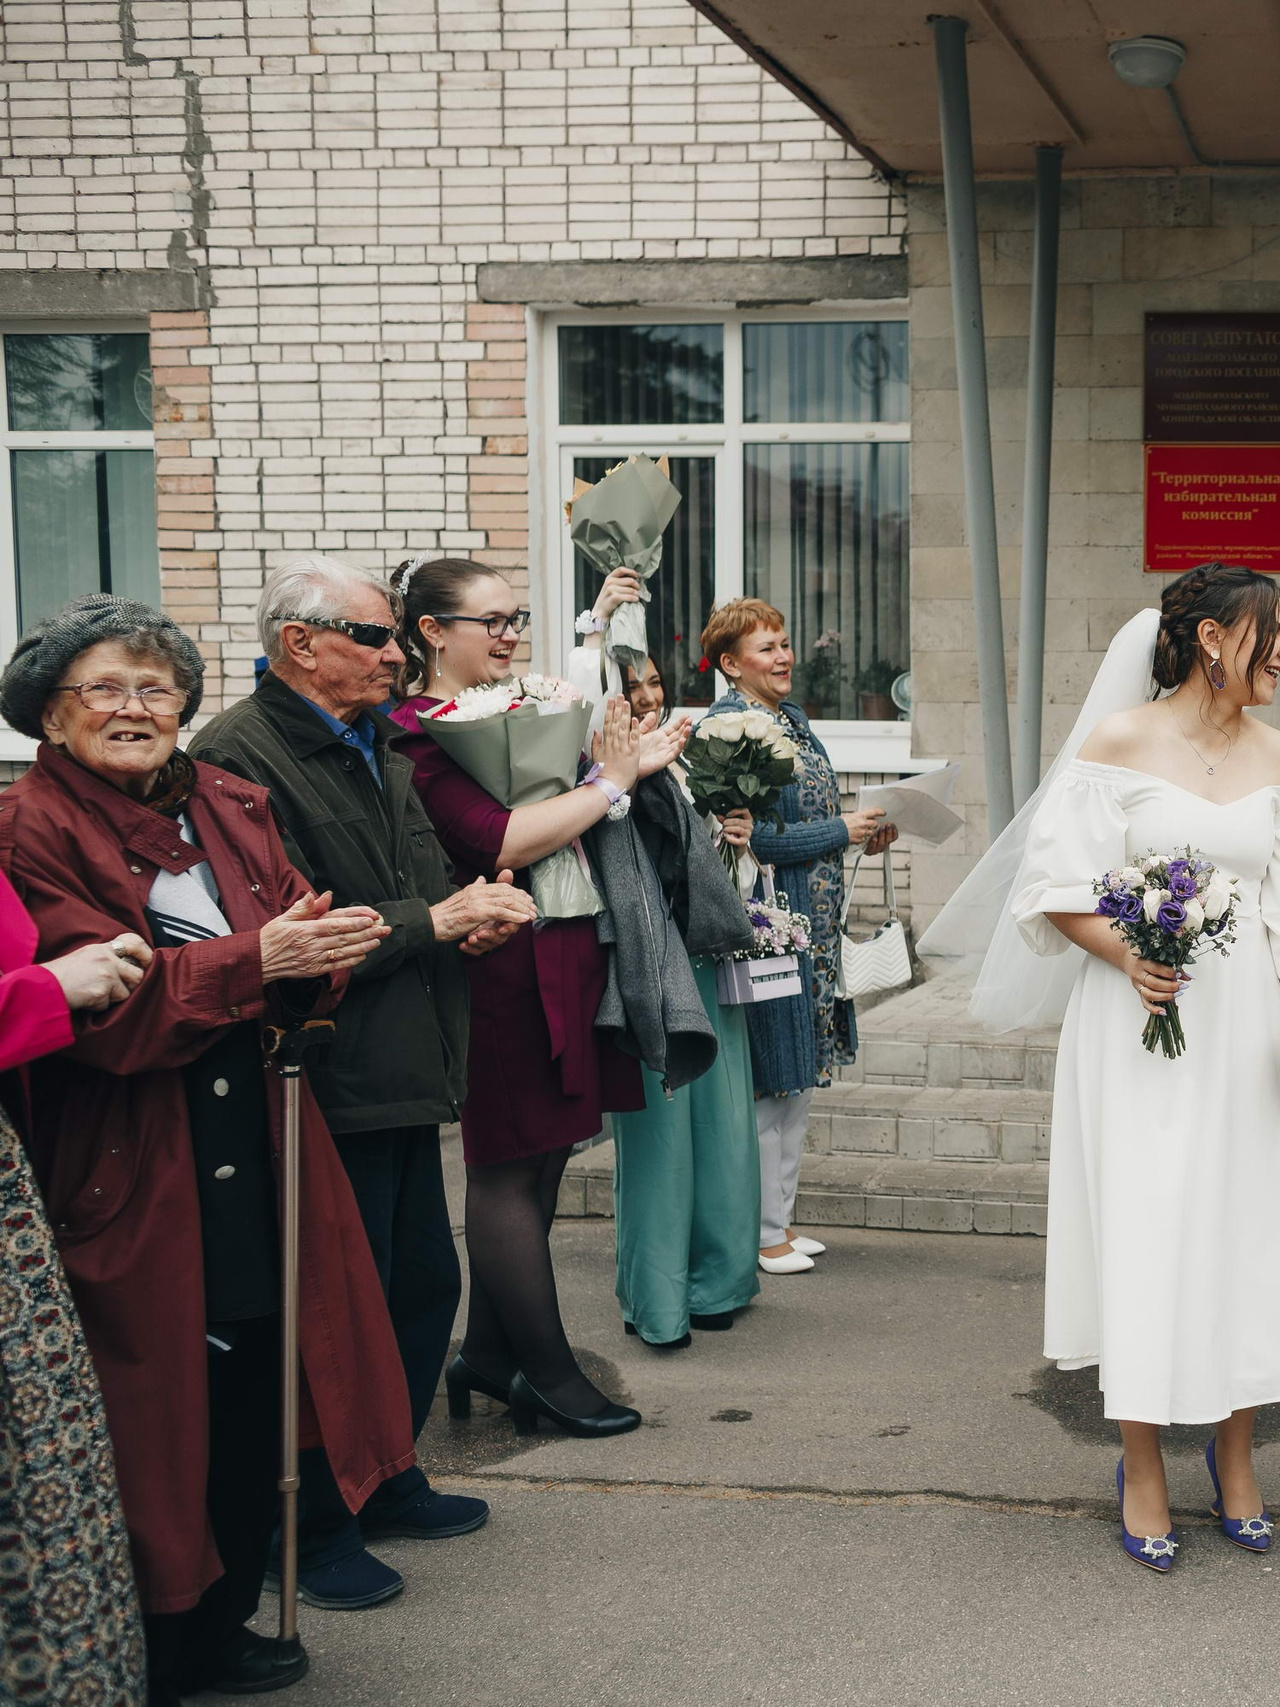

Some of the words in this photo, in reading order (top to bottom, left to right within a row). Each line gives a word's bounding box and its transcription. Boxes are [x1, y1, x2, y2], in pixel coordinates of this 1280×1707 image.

[1150, 331, 1201, 345] СОВЕТ
[1155, 368, 1222, 378] ГОРОДСКОГО
[1164, 489, 1277, 505] избирательная
[1181, 509, 1259, 521] комиссия"
